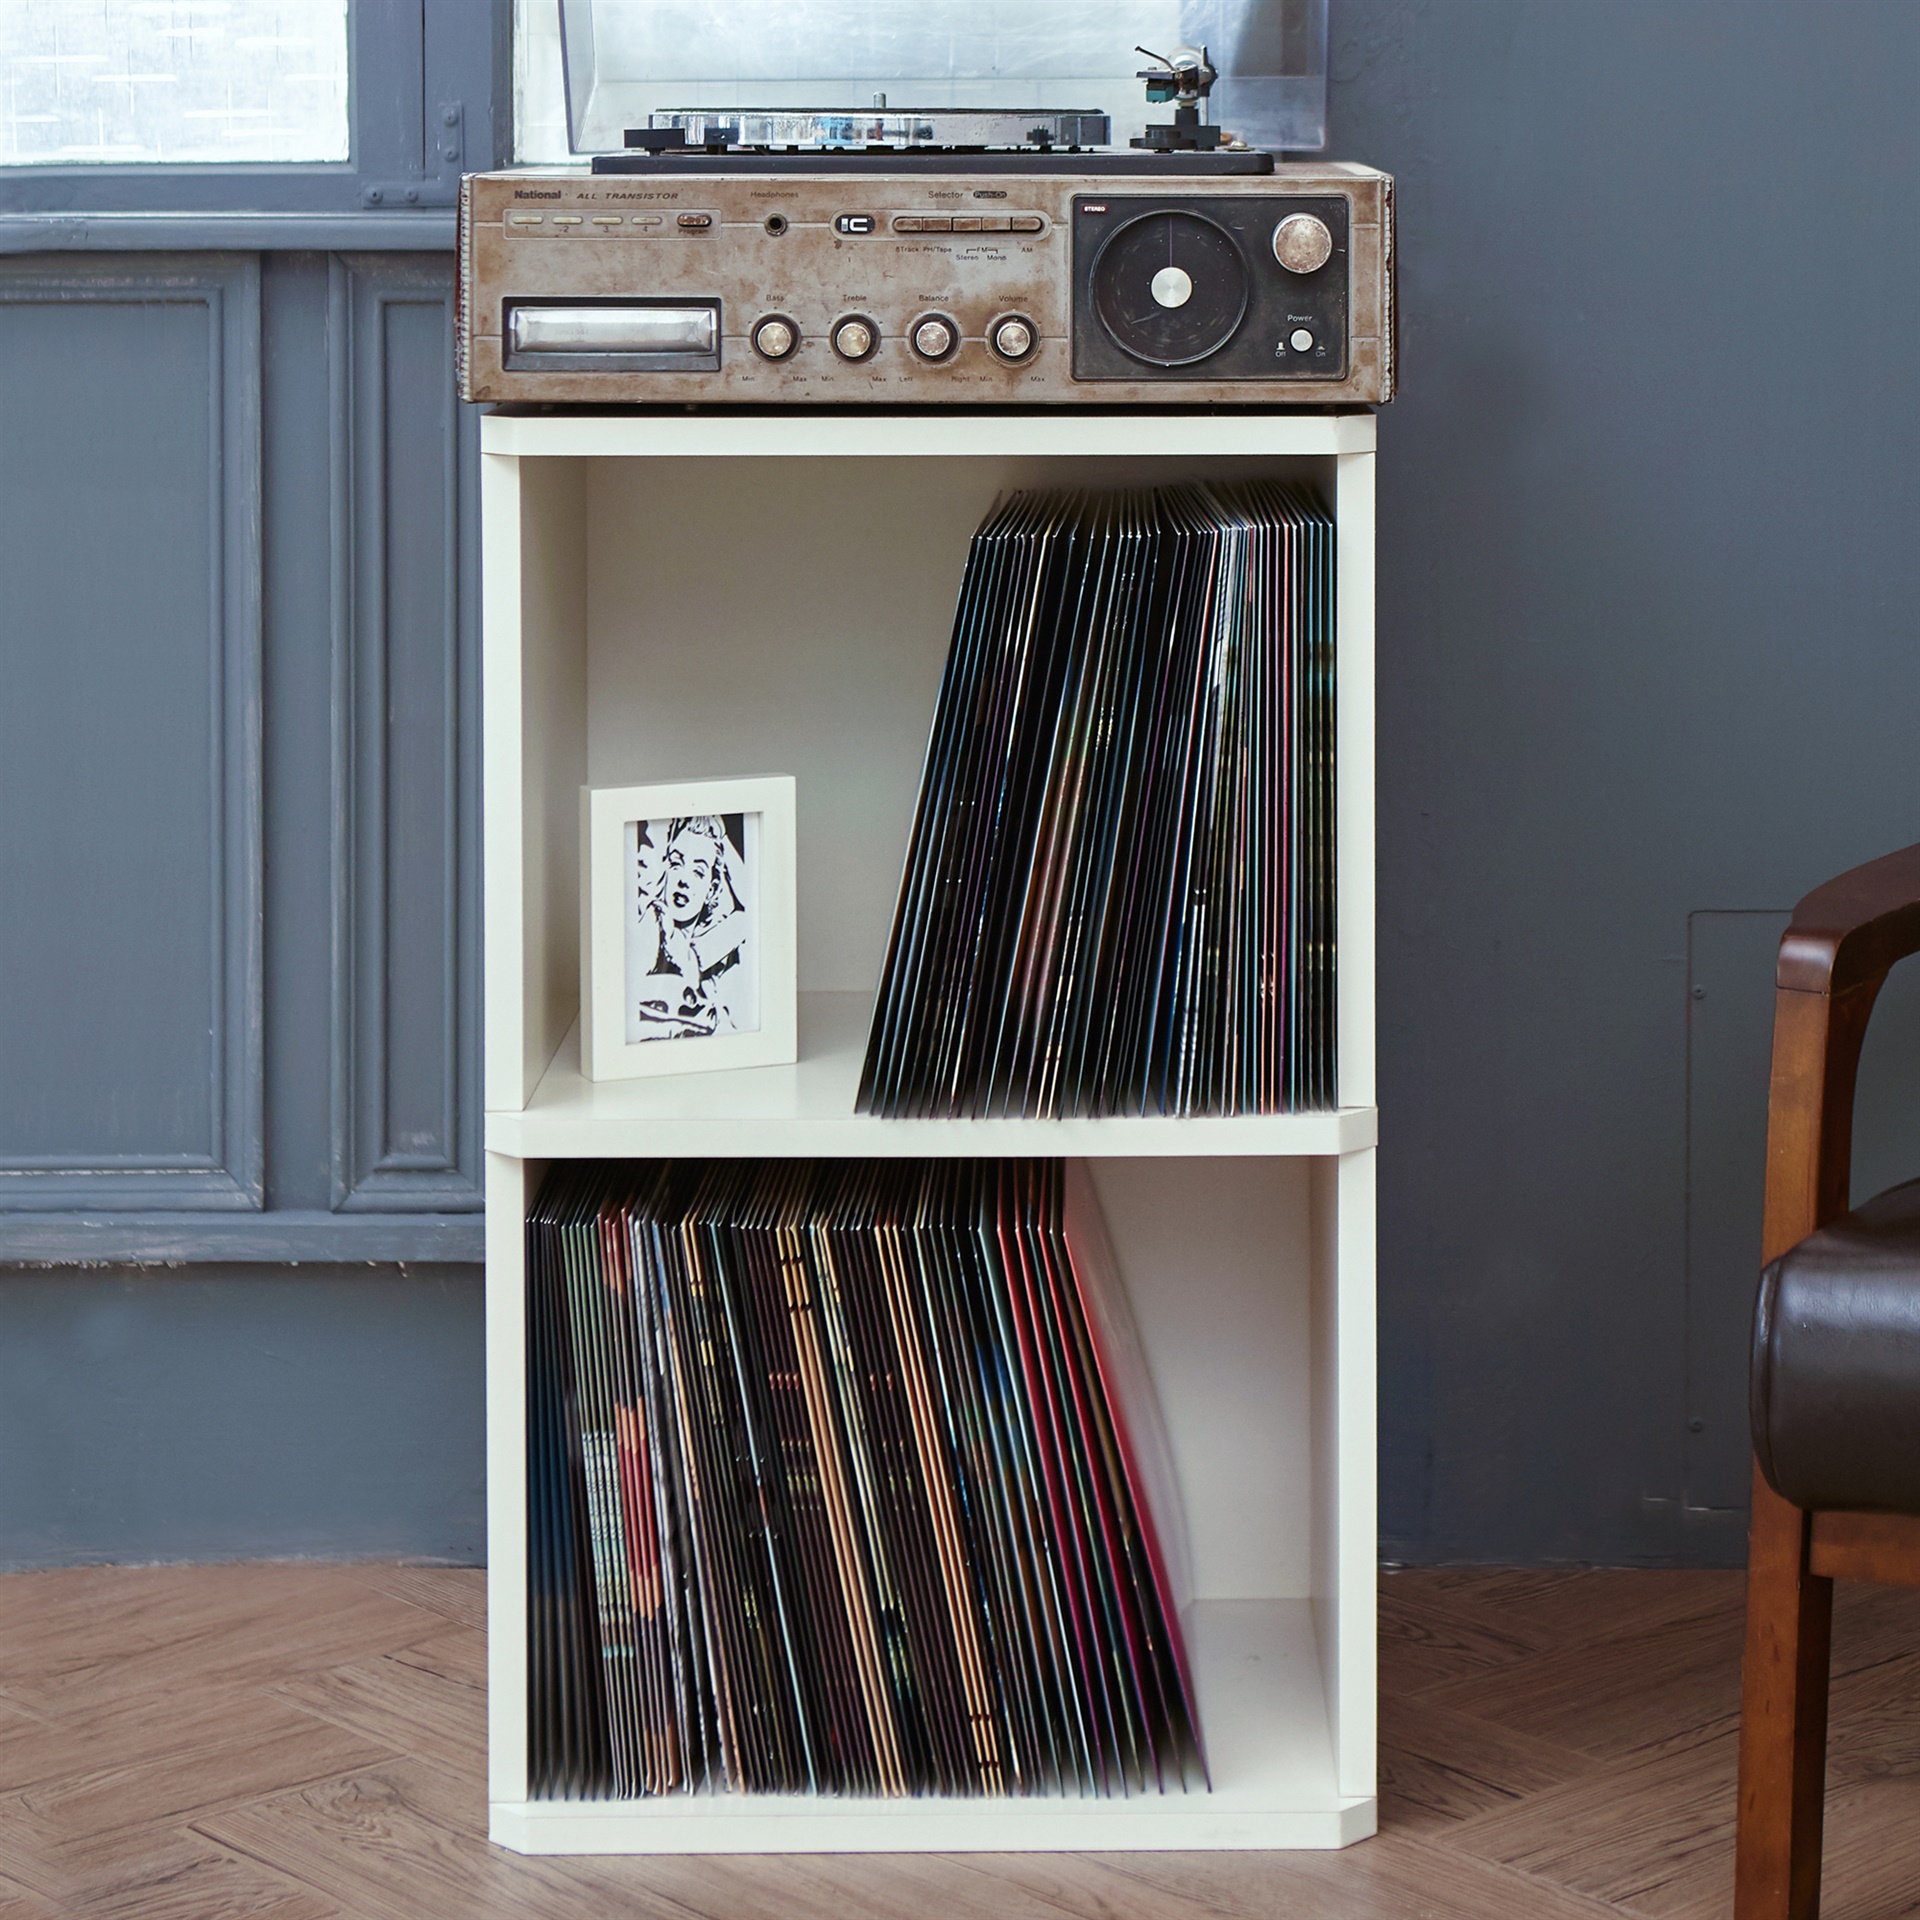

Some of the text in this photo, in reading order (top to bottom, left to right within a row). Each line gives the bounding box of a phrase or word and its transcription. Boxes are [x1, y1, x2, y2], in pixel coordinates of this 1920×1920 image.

[514, 190, 561, 200] National
[576, 192, 679, 200] ALL TRANSISTOR
[750, 191, 799, 200] Headphones
[928, 190, 964, 199] Selector
[841, 217, 868, 232] IC
[678, 227, 709, 236] Program
[766, 294, 785, 302] Bass
[843, 294, 867, 302] Treble
[918, 294, 949, 302] Balance
[999, 294, 1028, 303] Volume
[1287, 314, 1312, 323] Power
[1275, 350, 1286, 358] Off
